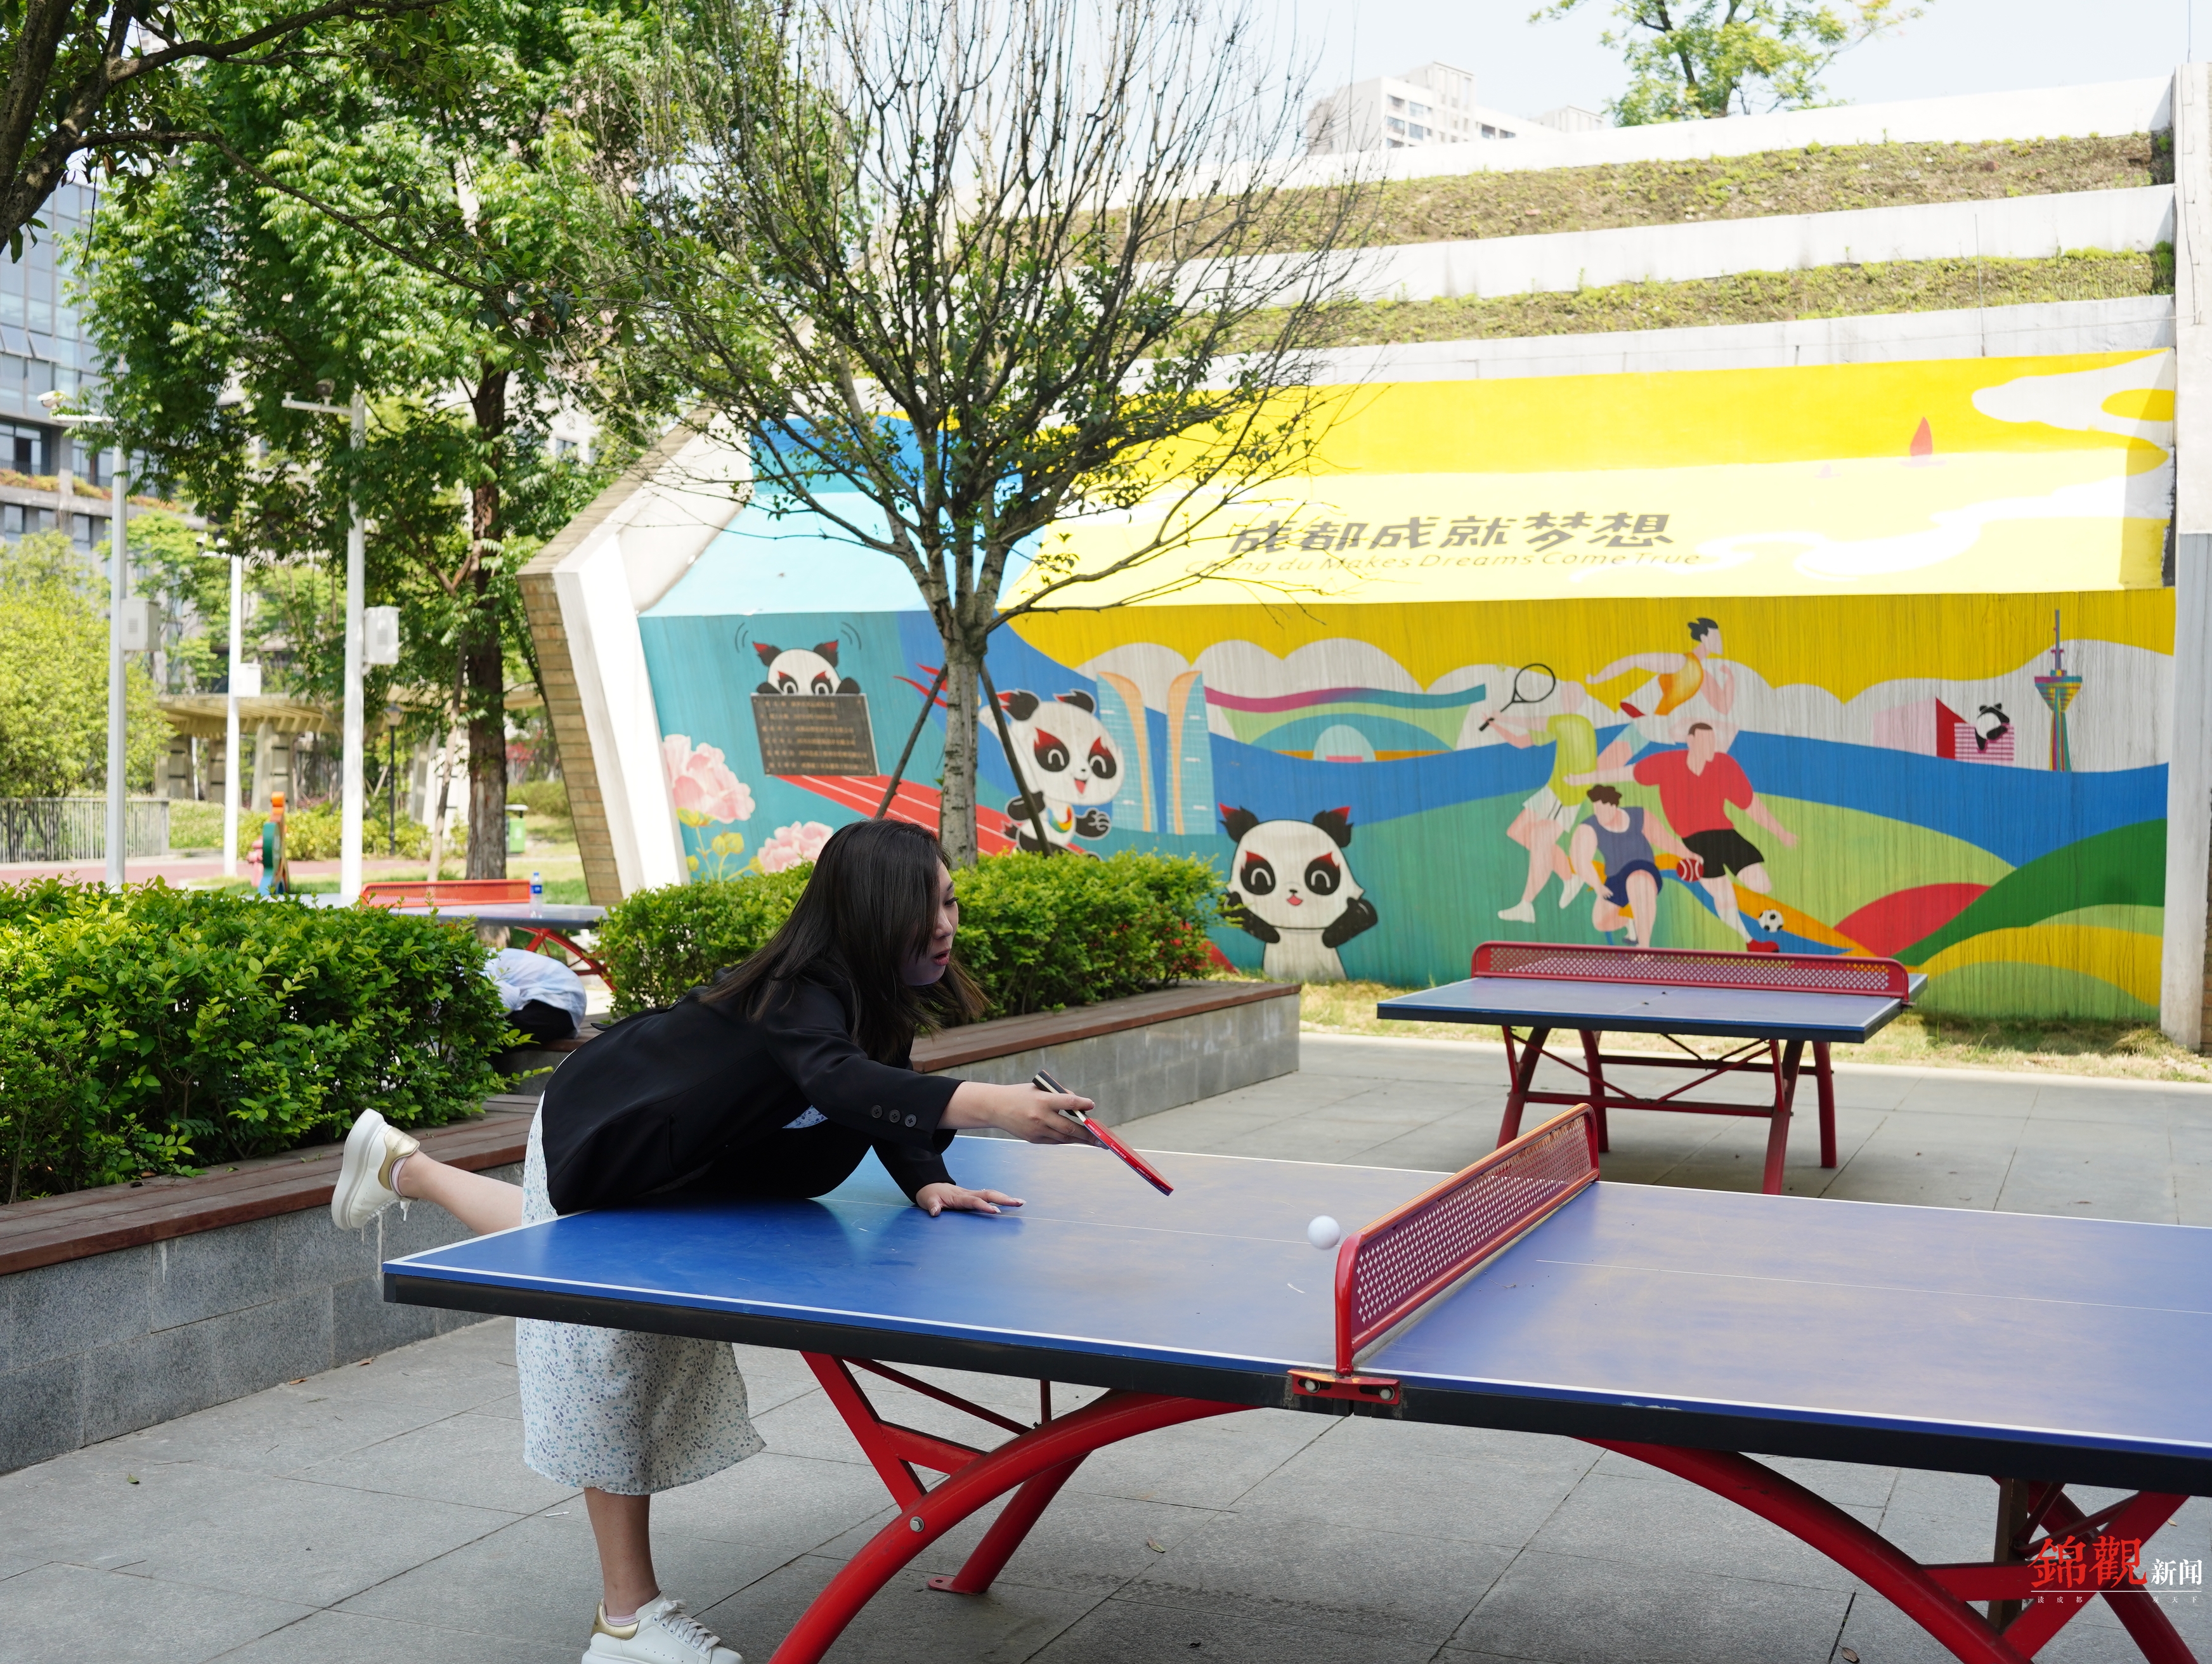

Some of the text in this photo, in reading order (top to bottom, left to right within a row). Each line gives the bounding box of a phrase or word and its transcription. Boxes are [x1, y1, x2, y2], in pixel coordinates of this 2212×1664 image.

[1228, 511, 1674, 554] 成都成就梦想
[1319, 554, 1412, 571] Makes
[1418, 553, 1535, 568] Dreams
[1542, 551, 1626, 565] Come
[1635, 552, 1700, 564] True
